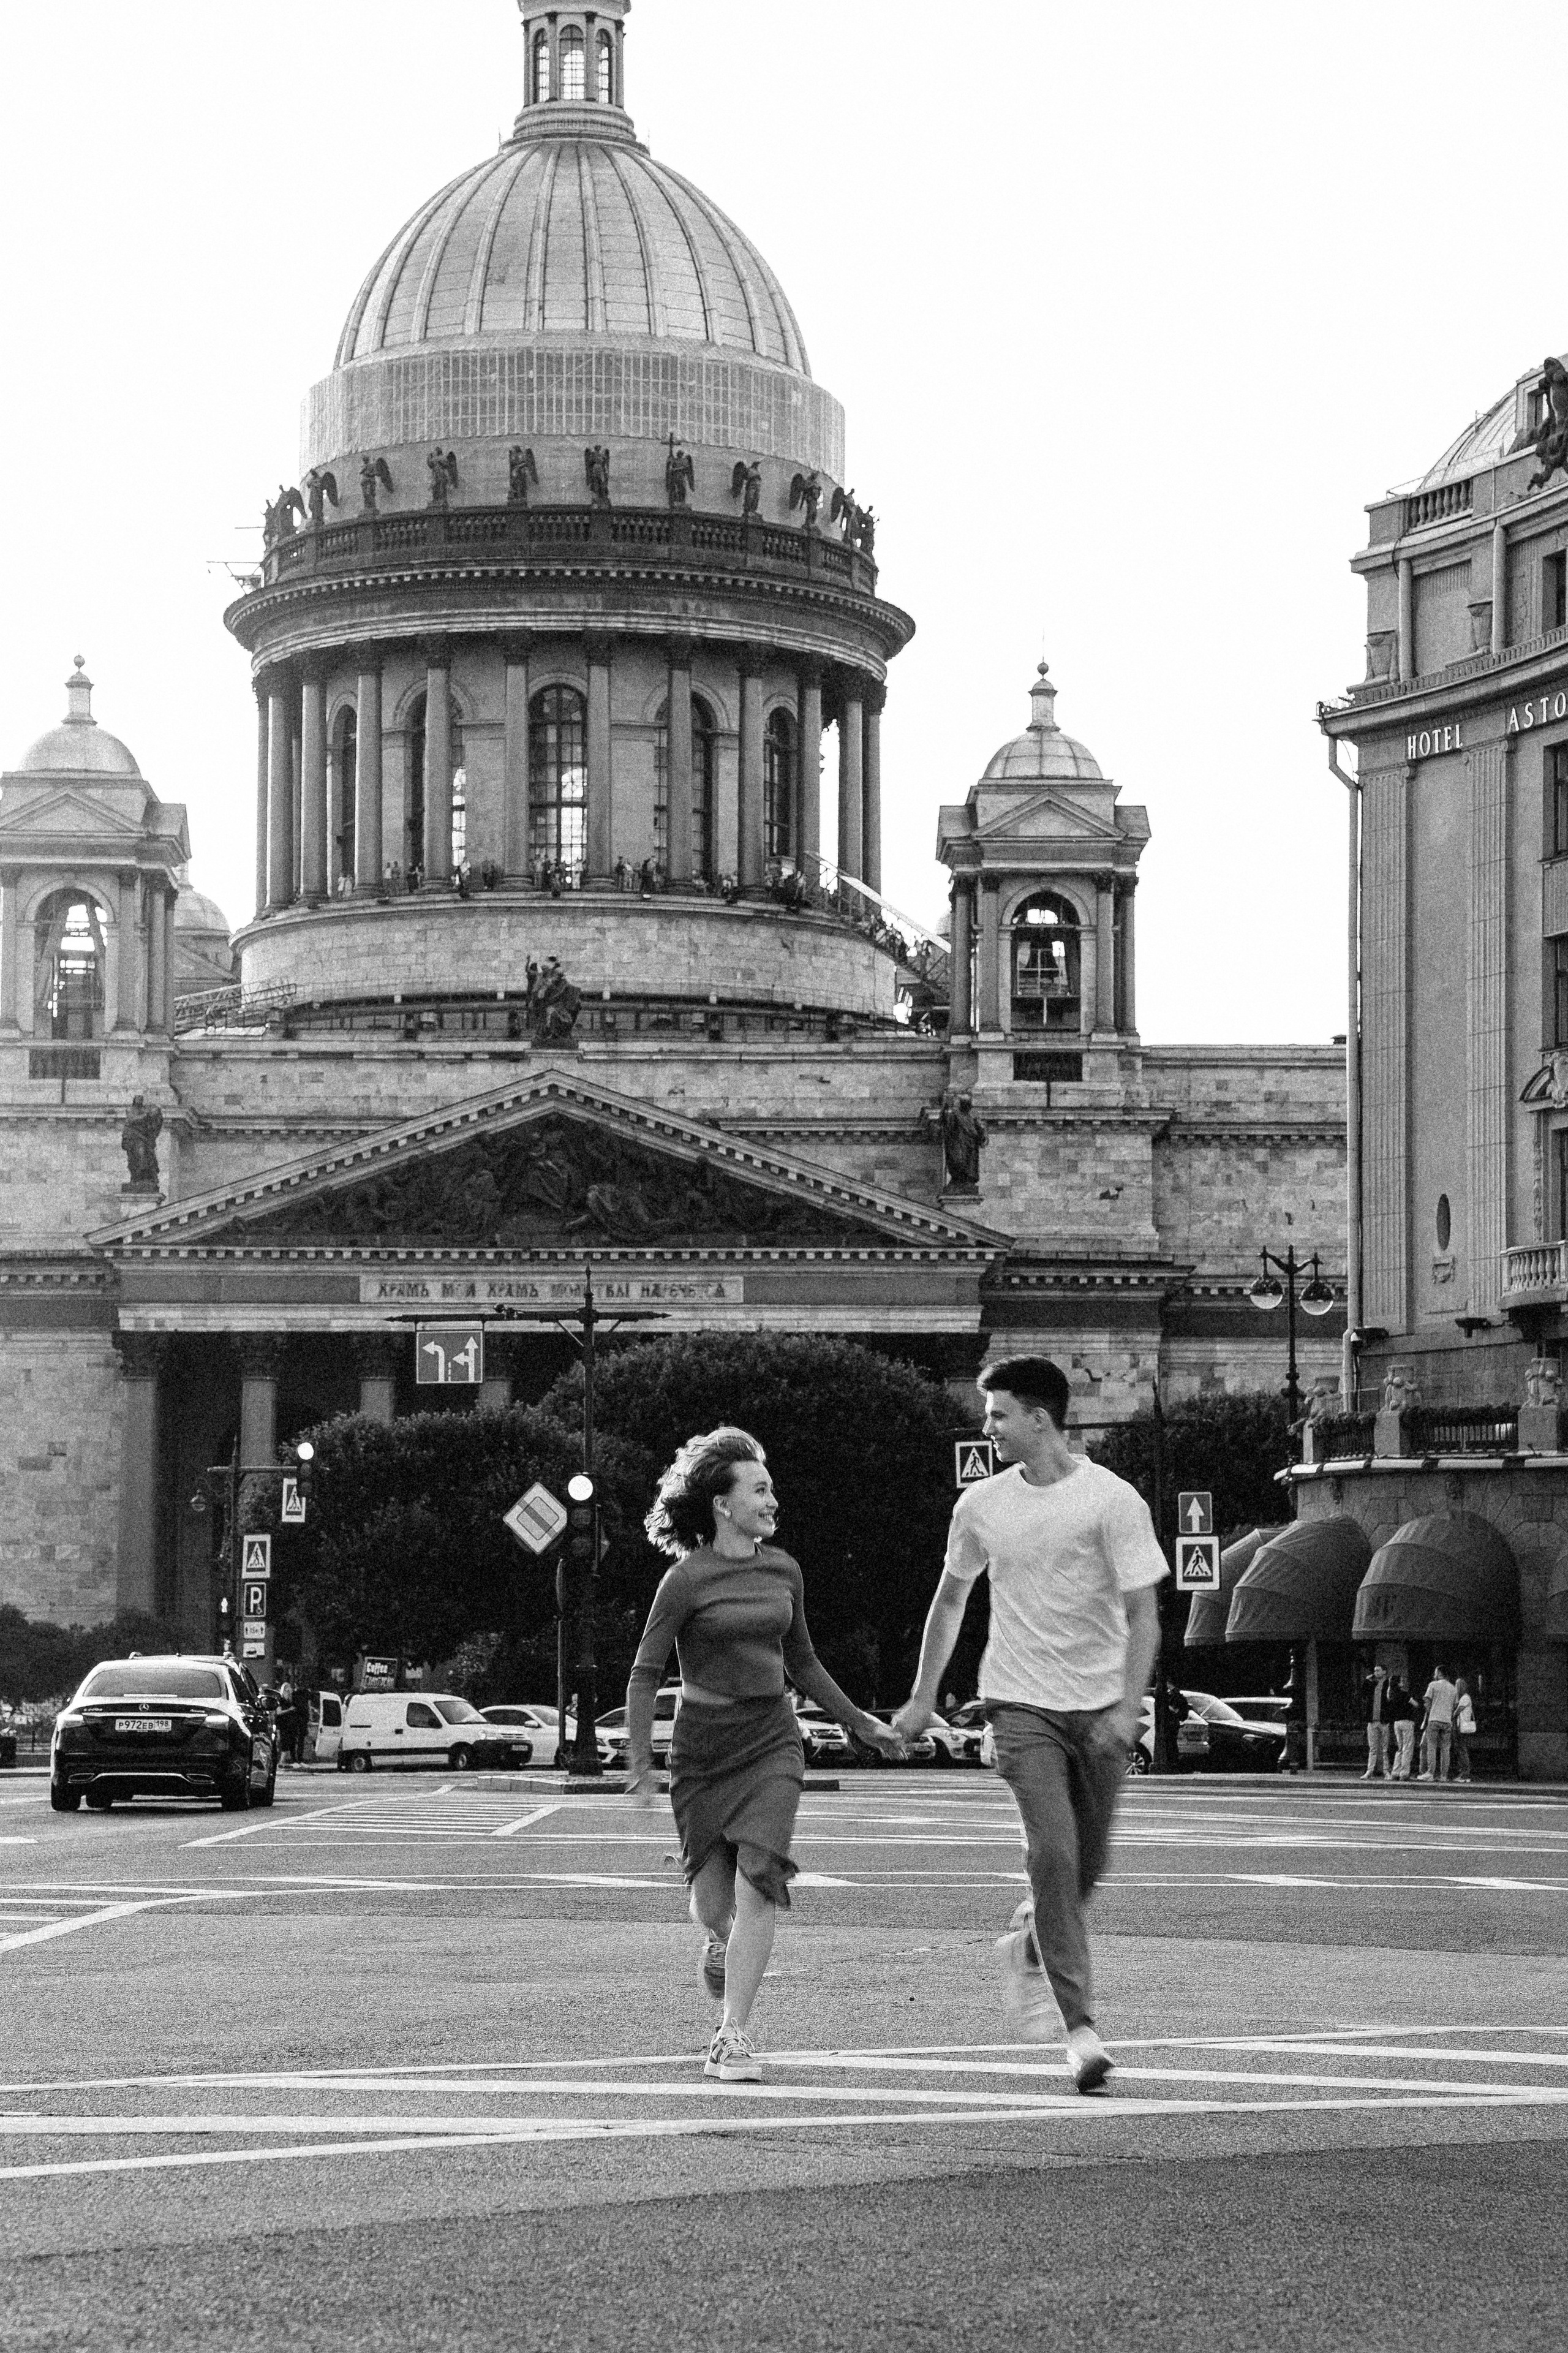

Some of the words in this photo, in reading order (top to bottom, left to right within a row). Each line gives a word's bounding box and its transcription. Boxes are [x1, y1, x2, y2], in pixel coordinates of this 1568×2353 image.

[1408, 724, 1463, 760] HOTEL
[1507, 692, 1567, 735] ASTO
[250, 1587, 262, 1613] P
[367, 1662, 388, 1675] Coffee
